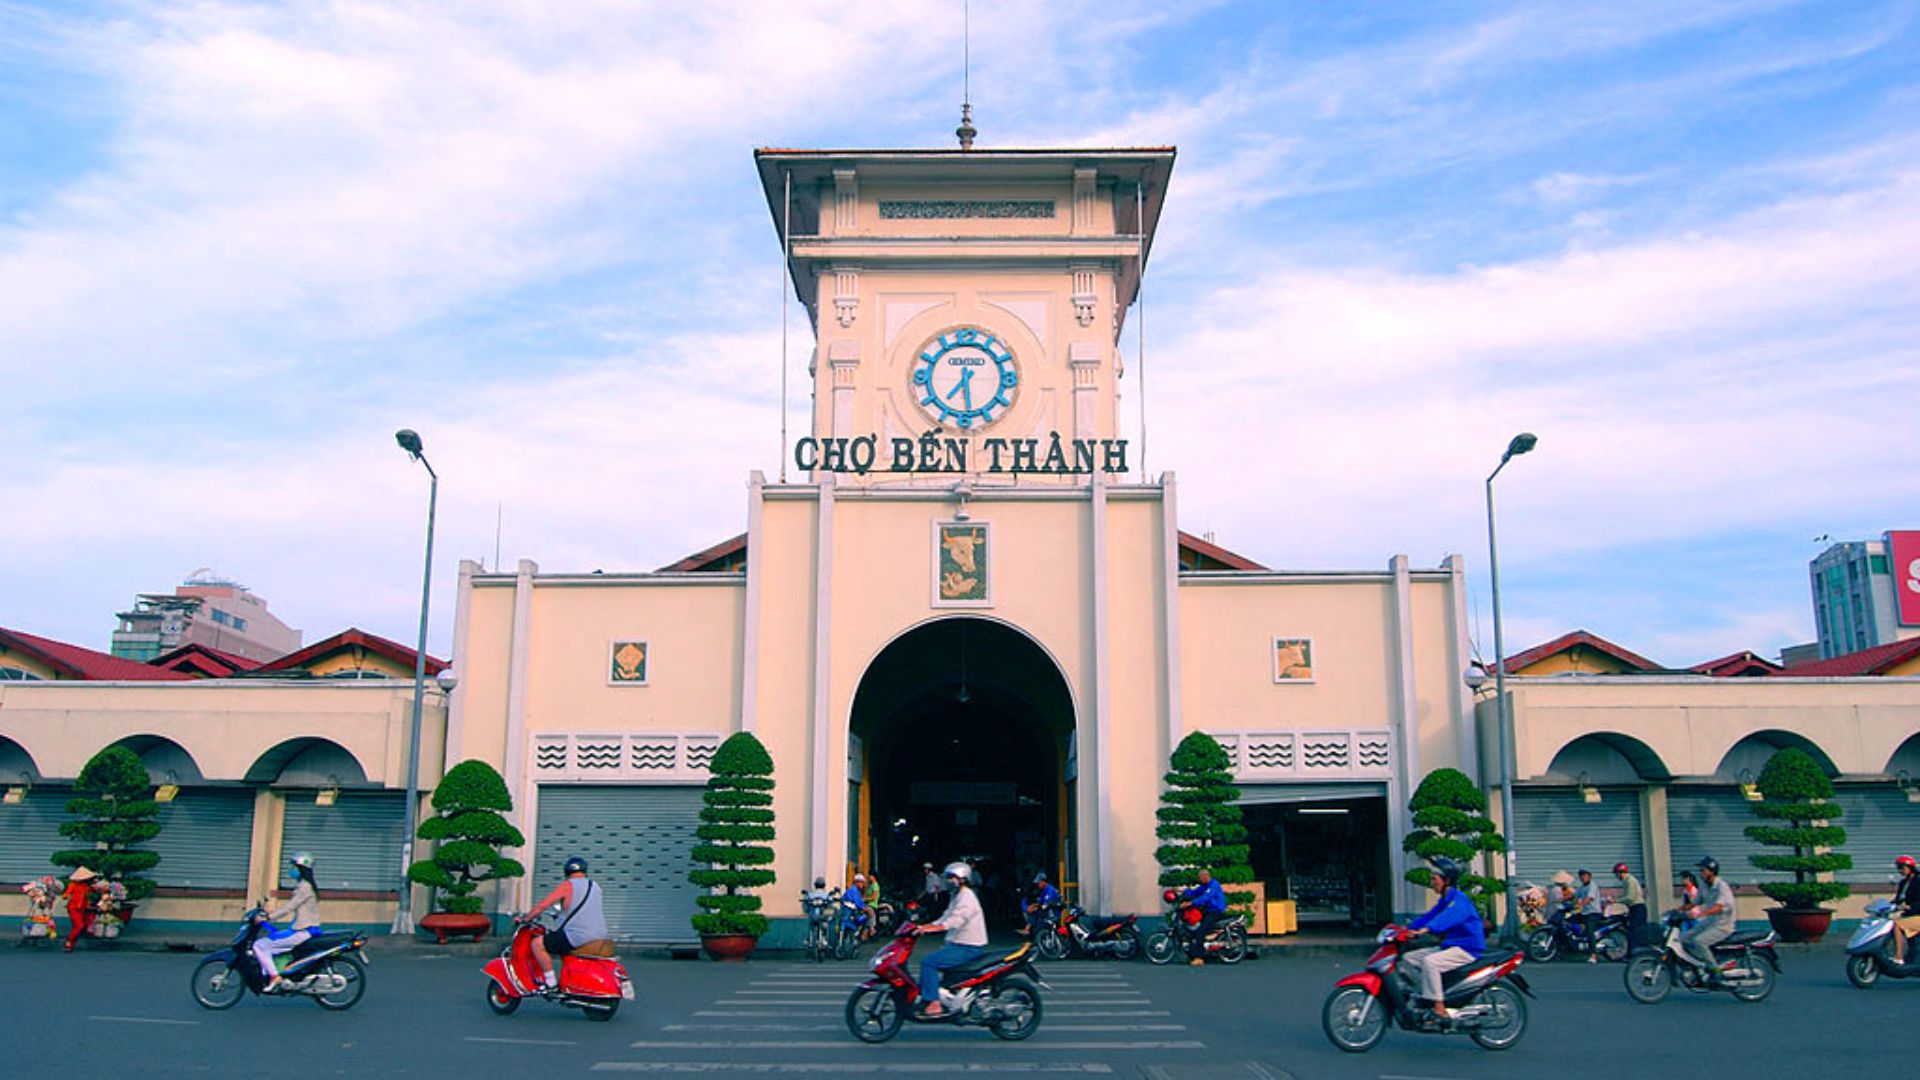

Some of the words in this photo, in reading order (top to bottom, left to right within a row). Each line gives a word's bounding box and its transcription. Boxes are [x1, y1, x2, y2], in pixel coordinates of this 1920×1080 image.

[795, 432, 877, 476] CHỢ
[892, 427, 968, 472] BẾN
[984, 431, 1129, 473] THÀNH
